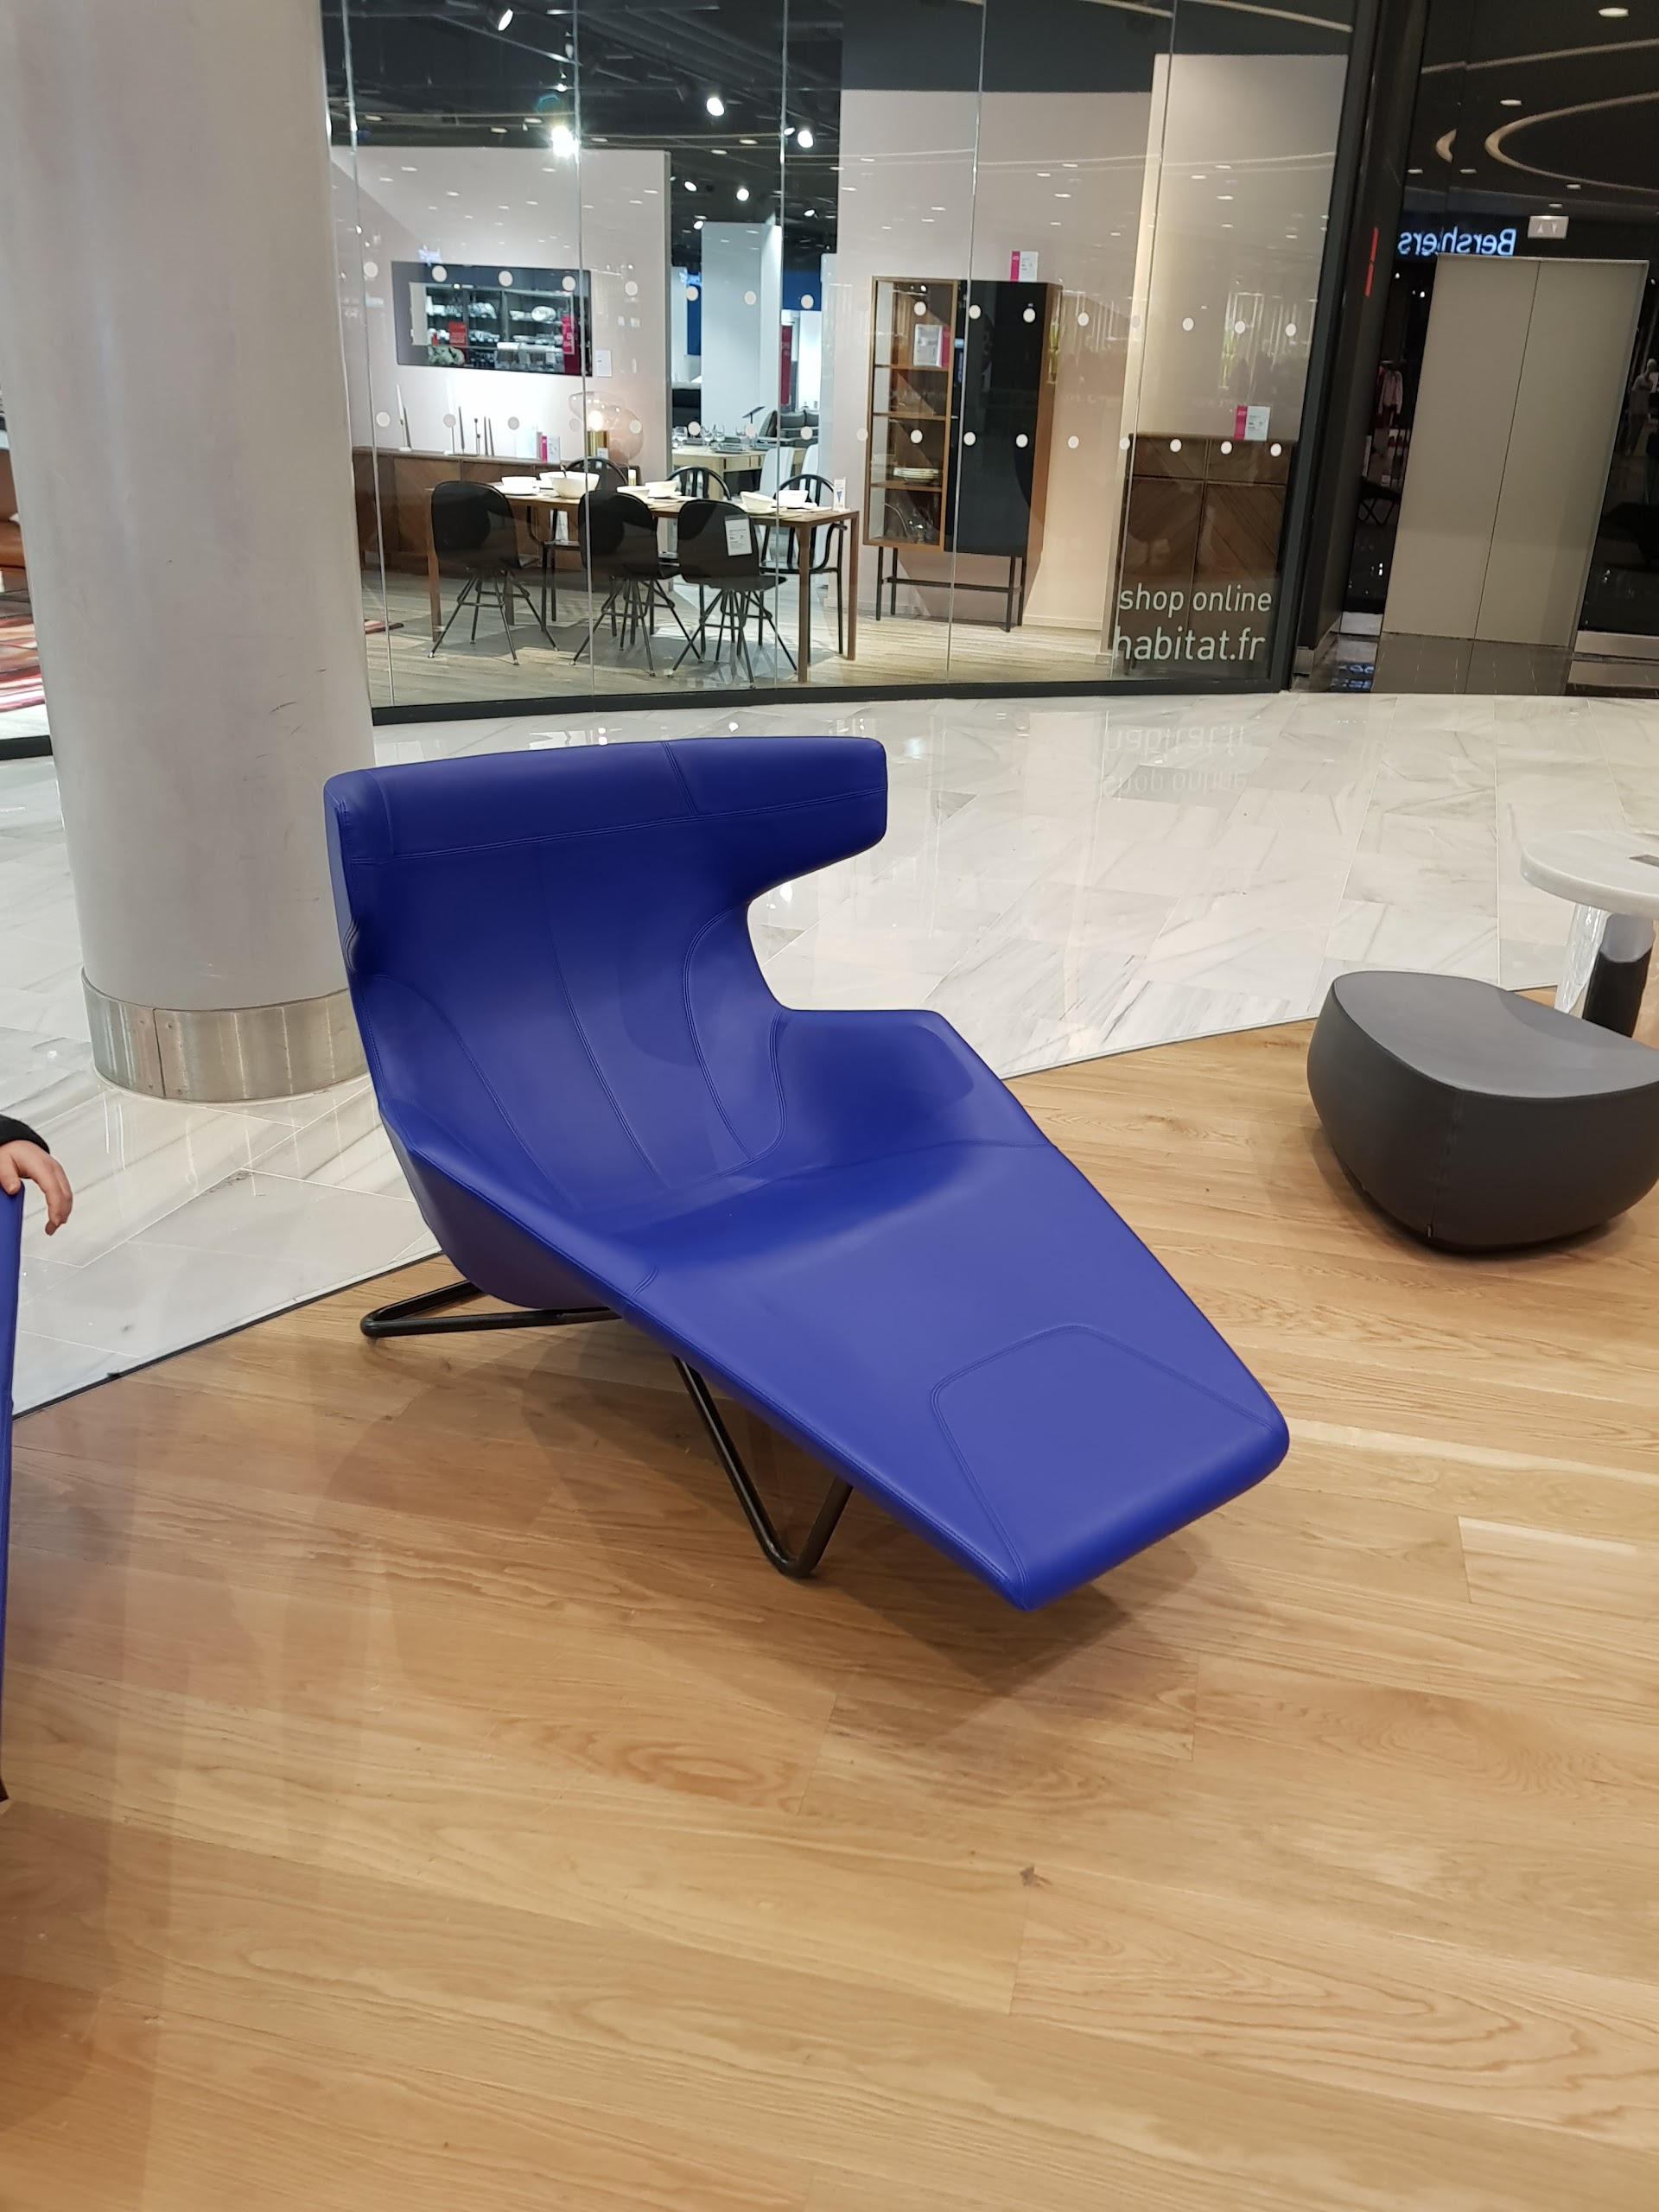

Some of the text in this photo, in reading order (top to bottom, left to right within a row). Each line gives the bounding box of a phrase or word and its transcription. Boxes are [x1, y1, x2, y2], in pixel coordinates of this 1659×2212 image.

[1119, 582, 1272, 618] shop online
[1113, 626, 1266, 661] habitat.fr
